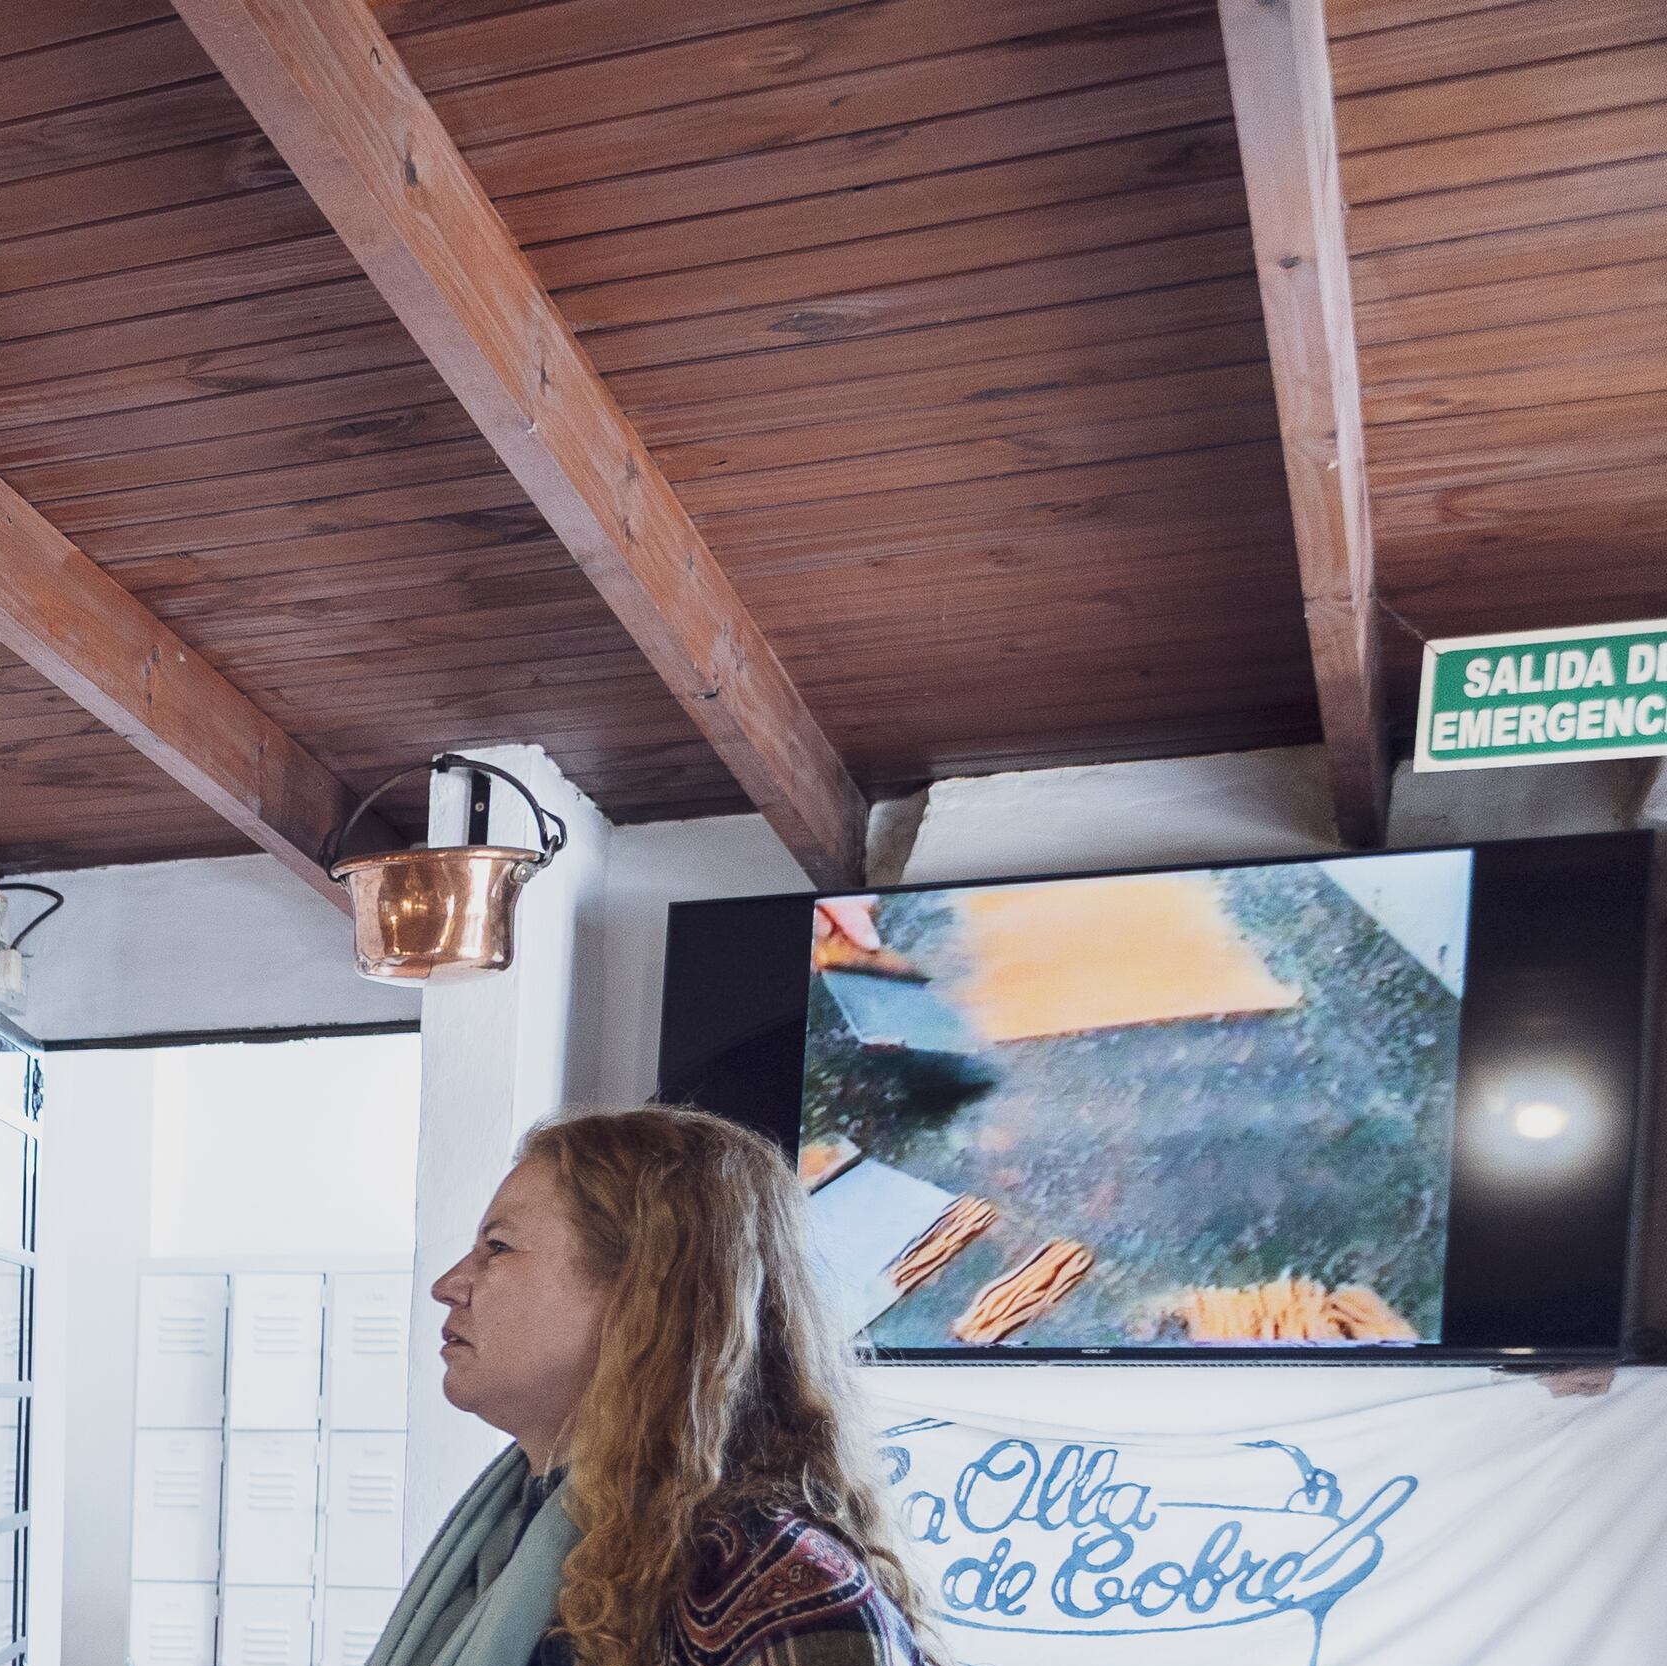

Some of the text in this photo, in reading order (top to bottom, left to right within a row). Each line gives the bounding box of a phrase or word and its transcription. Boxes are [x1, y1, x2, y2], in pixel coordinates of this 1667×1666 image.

[1463, 647, 1616, 698] SALIDA
[1431, 693, 1667, 751] EMERGENC
[954, 1439, 1157, 1534] Olla
[941, 1522, 1307, 1620] de Cobre
